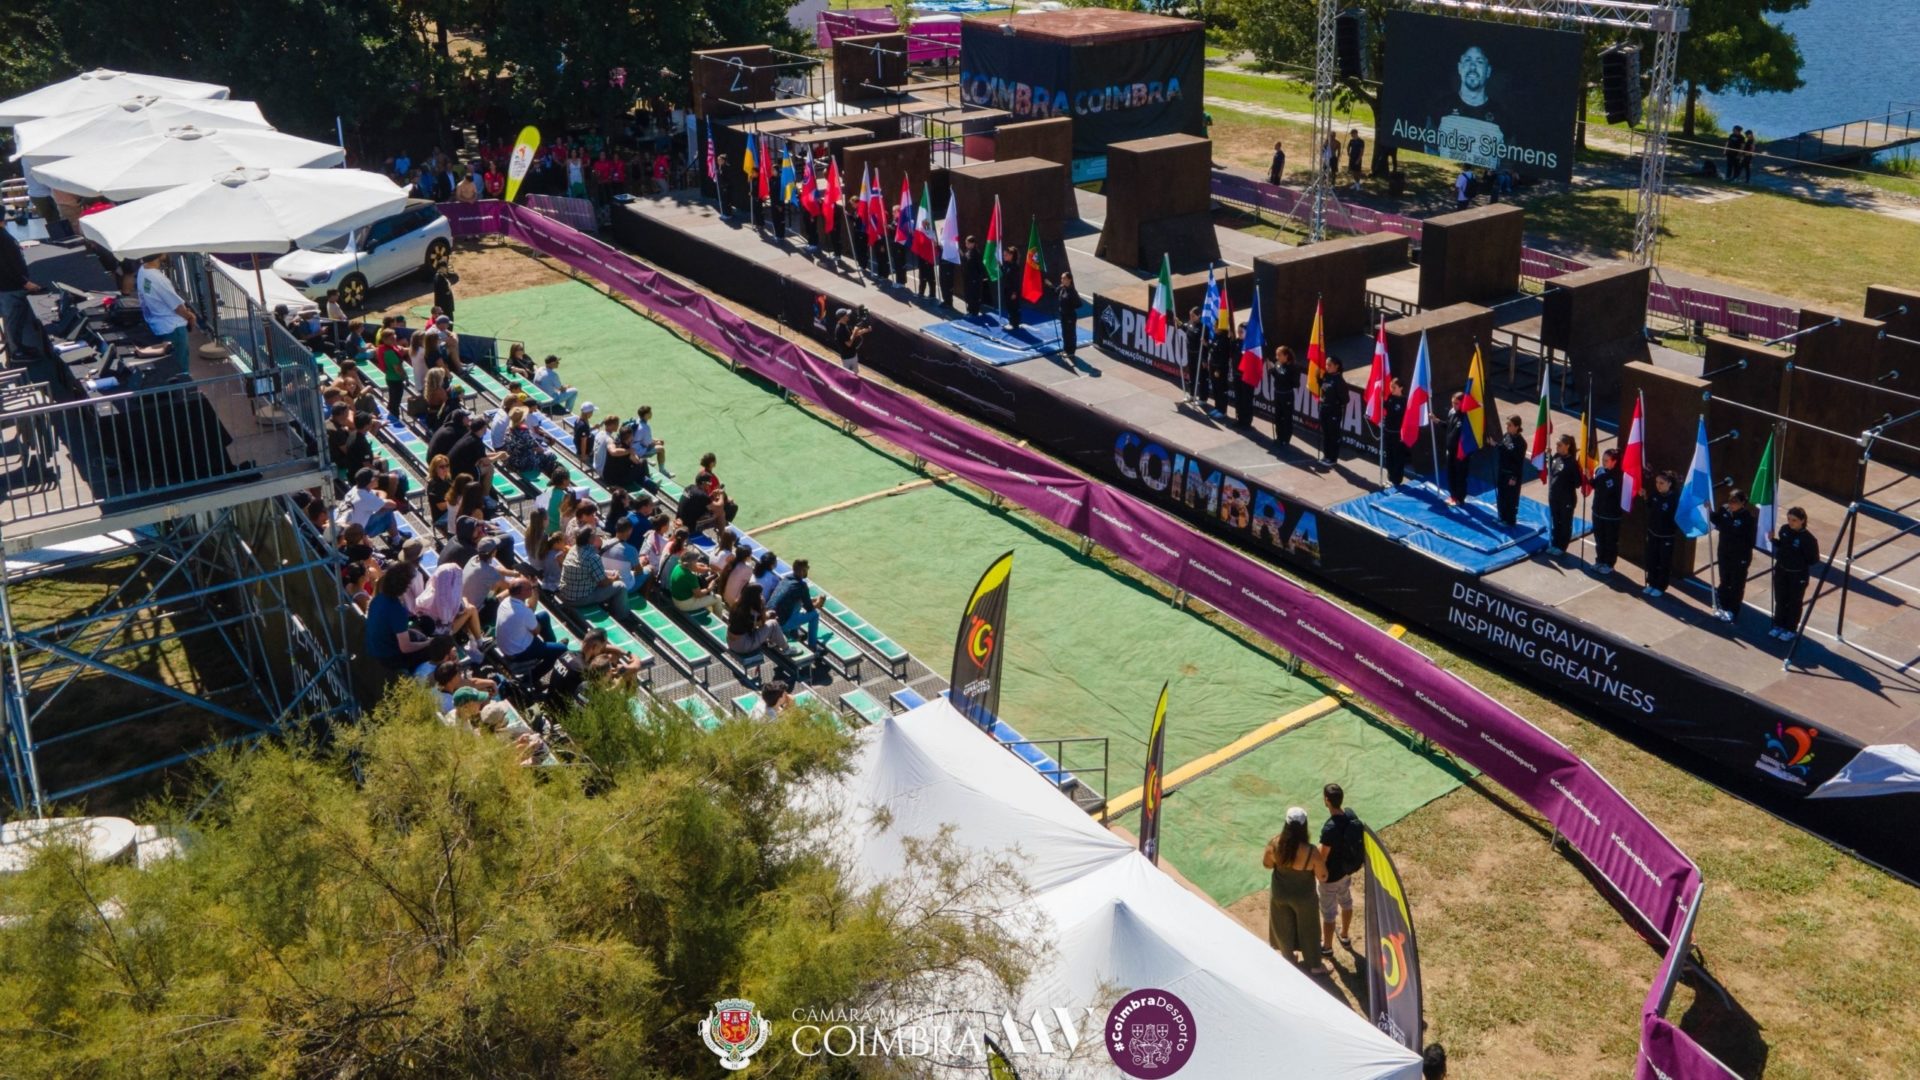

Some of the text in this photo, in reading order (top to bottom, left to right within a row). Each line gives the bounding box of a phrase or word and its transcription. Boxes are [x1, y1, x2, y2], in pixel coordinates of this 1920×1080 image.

[727, 56, 748, 92] 2
[1074, 77, 1183, 116] COIMBRA
[1392, 117, 1476, 153] Alexander
[1479, 133, 1558, 169] Siemens
[1114, 431, 1321, 564] COIMBRA
[1297, 618, 1345, 651] #CoimbraDesporto
[1452, 582, 1618, 671] DEFYING GRAVITY,
[1354, 653, 1405, 688] #CoimbraDesporto
[1448, 606, 1656, 714] INSPIRING GREATNESS
[1415, 690, 1469, 729] #CoimbraDesporto
[1480, 732, 1538, 774] #CoimbraDesporto
[1550, 778, 1601, 826] #CoimbraDesporto
[1610, 832, 1663, 888] #CoimbraDesporto
